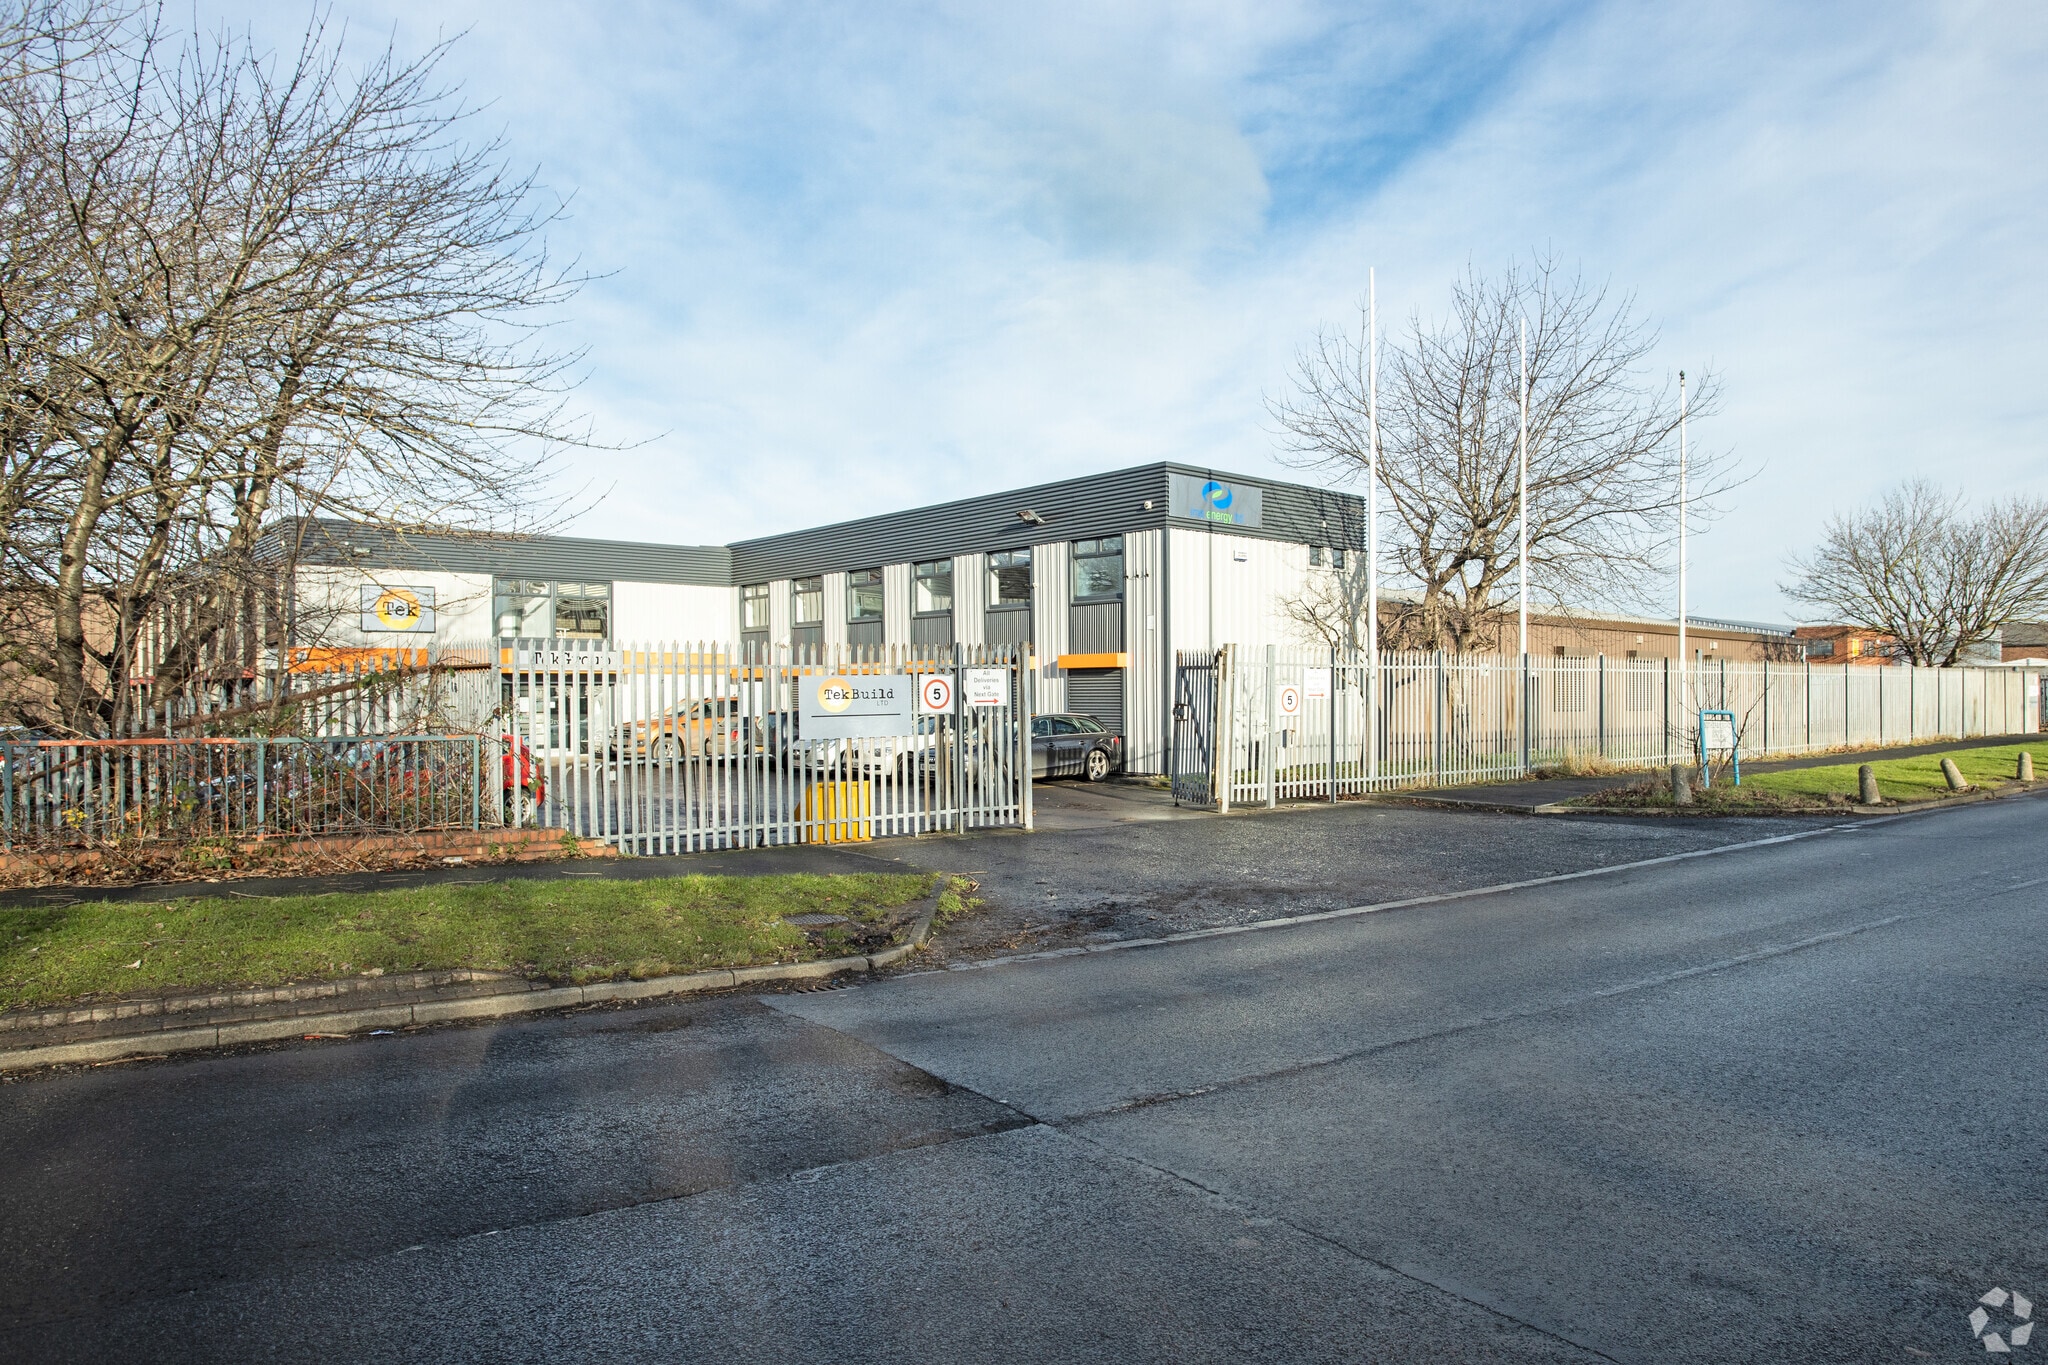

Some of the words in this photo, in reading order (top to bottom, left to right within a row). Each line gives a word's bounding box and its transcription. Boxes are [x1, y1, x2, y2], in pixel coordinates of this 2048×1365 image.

[1206, 510, 1233, 524] energy
[383, 602, 419, 618] Tek
[933, 688, 941, 700] 5
[1287, 695, 1293, 705] 5
